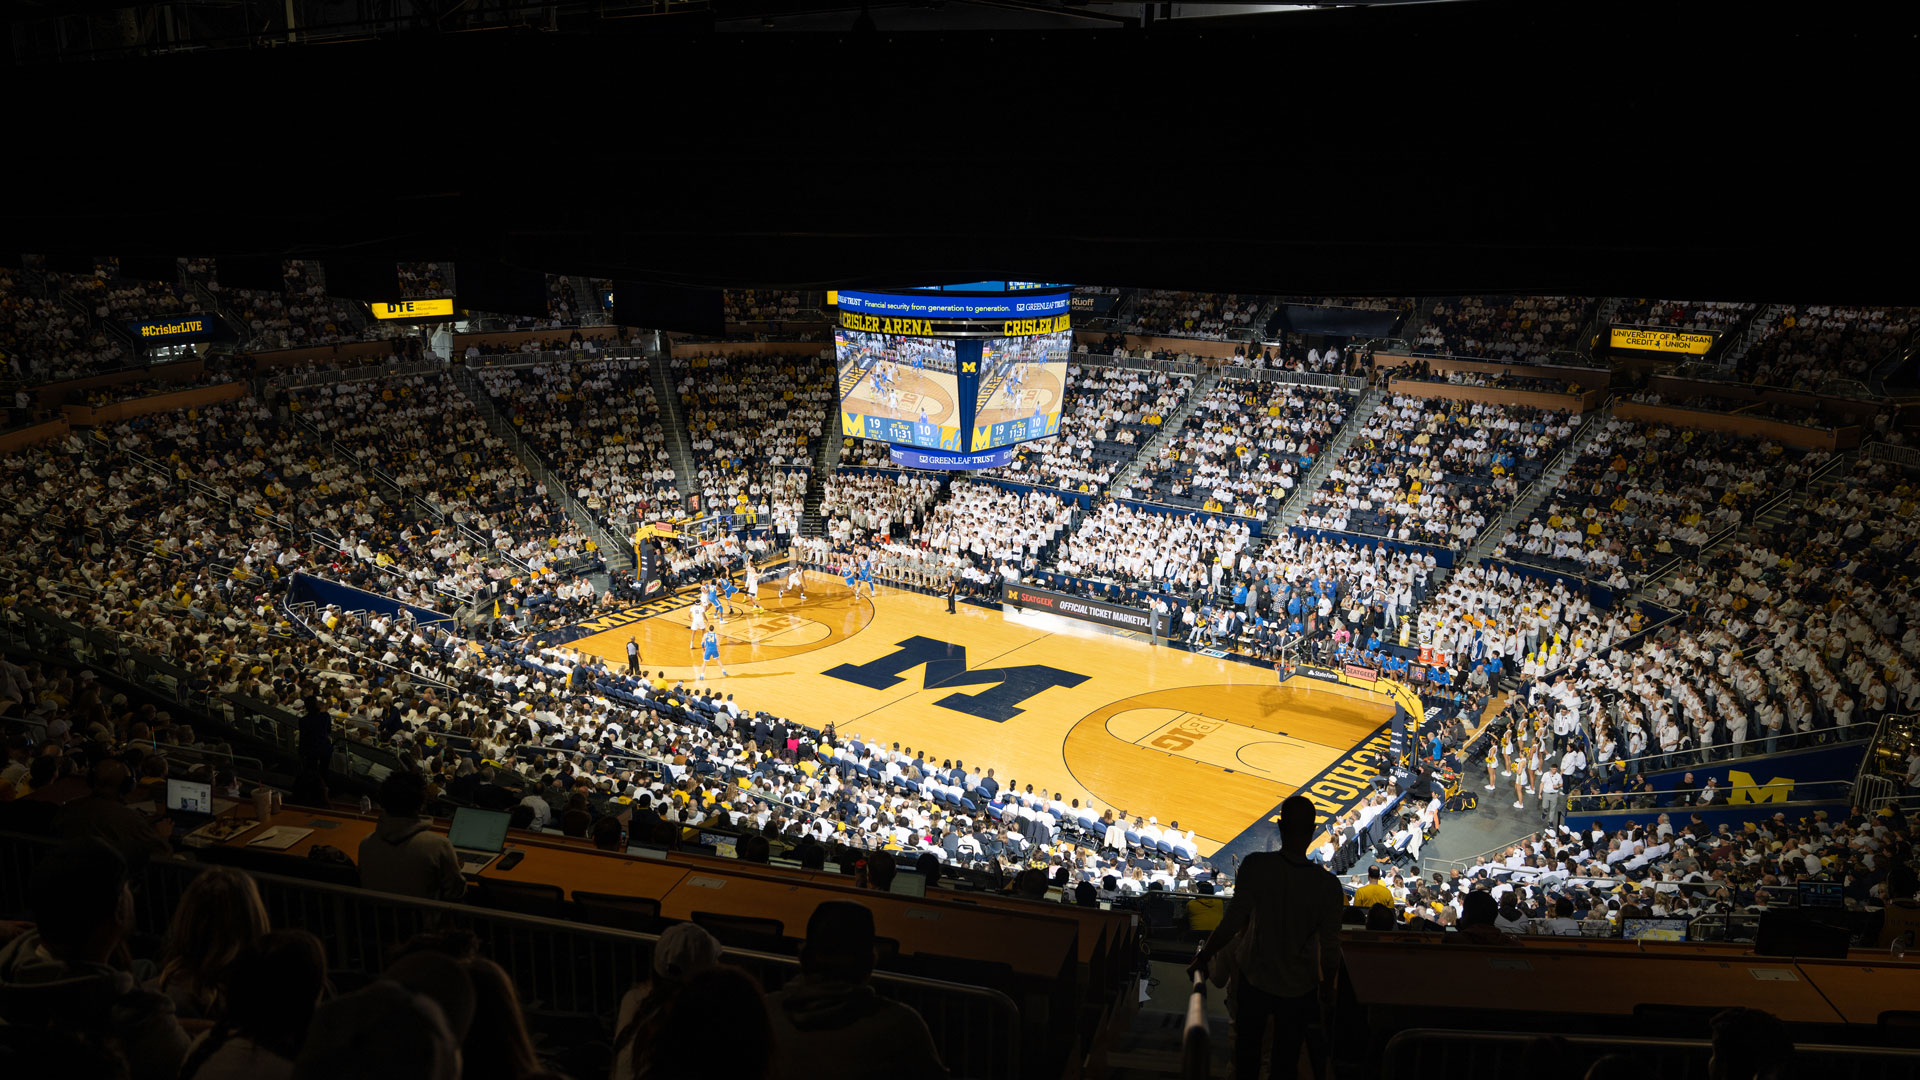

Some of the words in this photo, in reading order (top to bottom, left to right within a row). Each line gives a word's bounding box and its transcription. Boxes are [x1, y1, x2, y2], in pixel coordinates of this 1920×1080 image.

[388, 302, 414, 313] DTE
[865, 300, 886, 309] Financial
[887, 302, 909, 311] security
[911, 303, 926, 311] from
[928, 304, 964, 313] generation
[966, 304, 973, 312] to
[975, 304, 1010, 313] generation.
[1026, 301, 1054, 311] GREENLEAF
[1055, 299, 1066, 308] TRUST
[141, 320, 203, 337] #CrislerLIVE
[842, 312, 880, 333] CRISLER
[883, 318, 934, 336] ARENA
[1004, 318, 1051, 337] CRISLER
[1613, 330, 1658, 340] UNIVERSITY
[1660, 333, 1669, 341] OF
[1672, 334, 1711, 344] MICHIGAN
[1626, 337, 1655, 347] CREDIT
[1665, 341, 1691, 349] UNION
[962, 361, 977, 373] M
[869, 418, 881, 429] 19
[1032, 417, 1040, 428] 10
[889, 427, 912, 440] 11:31
[919, 424, 931, 436] 10
[995, 425, 1004, 436] 19
[1009, 427, 1026, 439] 11:31
[929, 455, 971, 465] GREENLEAF
[972, 454, 996, 465] TRUST
[1008, 589, 1018, 601] M
[1021, 592, 1053, 608] SEATGEEK
[1060, 600, 1088, 615] OFFICIAL
[1089, 606, 1112, 618] TICKET
[1346, 667, 1376, 680] SEATGEEK
[1726, 769, 1795, 806] M
